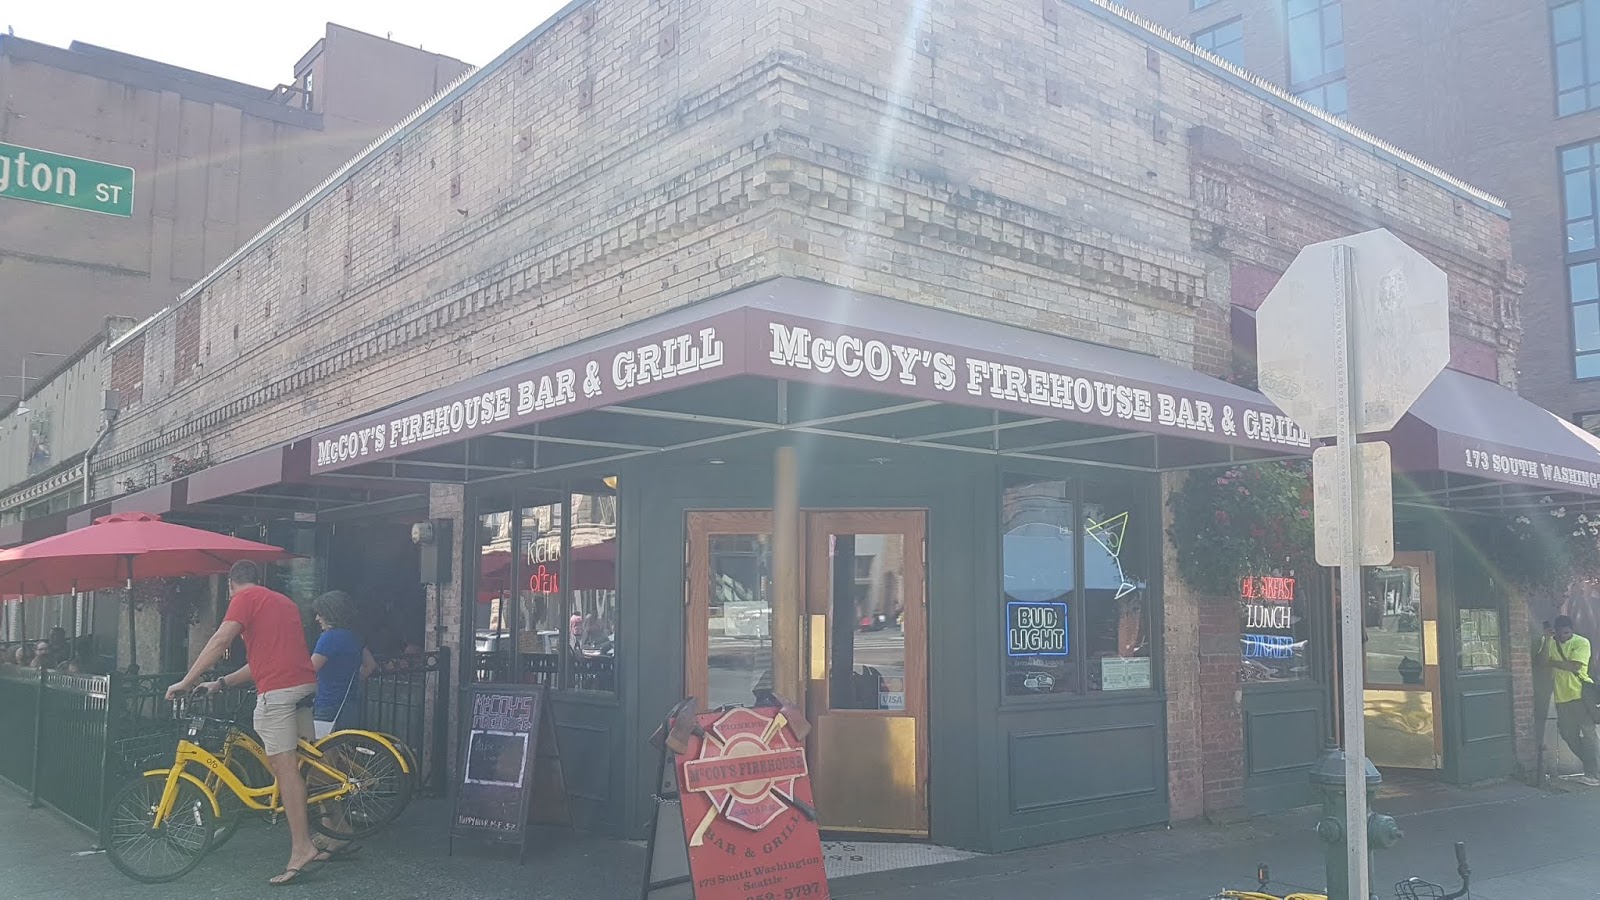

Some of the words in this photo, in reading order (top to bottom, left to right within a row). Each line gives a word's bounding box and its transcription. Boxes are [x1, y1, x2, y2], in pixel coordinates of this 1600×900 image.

[95, 182, 123, 204] ST
[769, 322, 956, 391] McCOY'S
[965, 357, 1152, 422] FIREHOUSE
[1157, 393, 1215, 433] BAR
[1221, 405, 1237, 437] &
[317, 423, 386, 467] McCOY'S
[389, 387, 511, 449] FIREHOUSE
[516, 367, 576, 415] BAR
[582, 360, 603, 399] &
[612, 327, 723, 391] GRILL
[1465, 448, 1490, 470] 173
[1492, 454, 1539, 479] SOUTH
[1242, 576, 1296, 600] BAKFAST
[1017, 606, 1058, 628] BUD
[1246, 604, 1291, 629] LUNCH
[1010, 629, 1064, 650] LIGHT
[1245, 634, 1295, 659] DINNER
[882, 695, 903, 704] VISA
[720, 720, 767, 731] PIONEER
[253, 745, 263, 755] ofo
[206, 758, 218, 769] ofo
[739, 755, 804, 776] FIREHOUSE
[705, 827, 736, 855] BAR
[744, 847, 756, 858] &
[763, 813, 801, 854] GRILL
[699, 877, 717, 888] 173
[719, 870, 752, 884] South
[753, 855, 820, 876] Washington
[743, 876, 783, 892] Seattle
